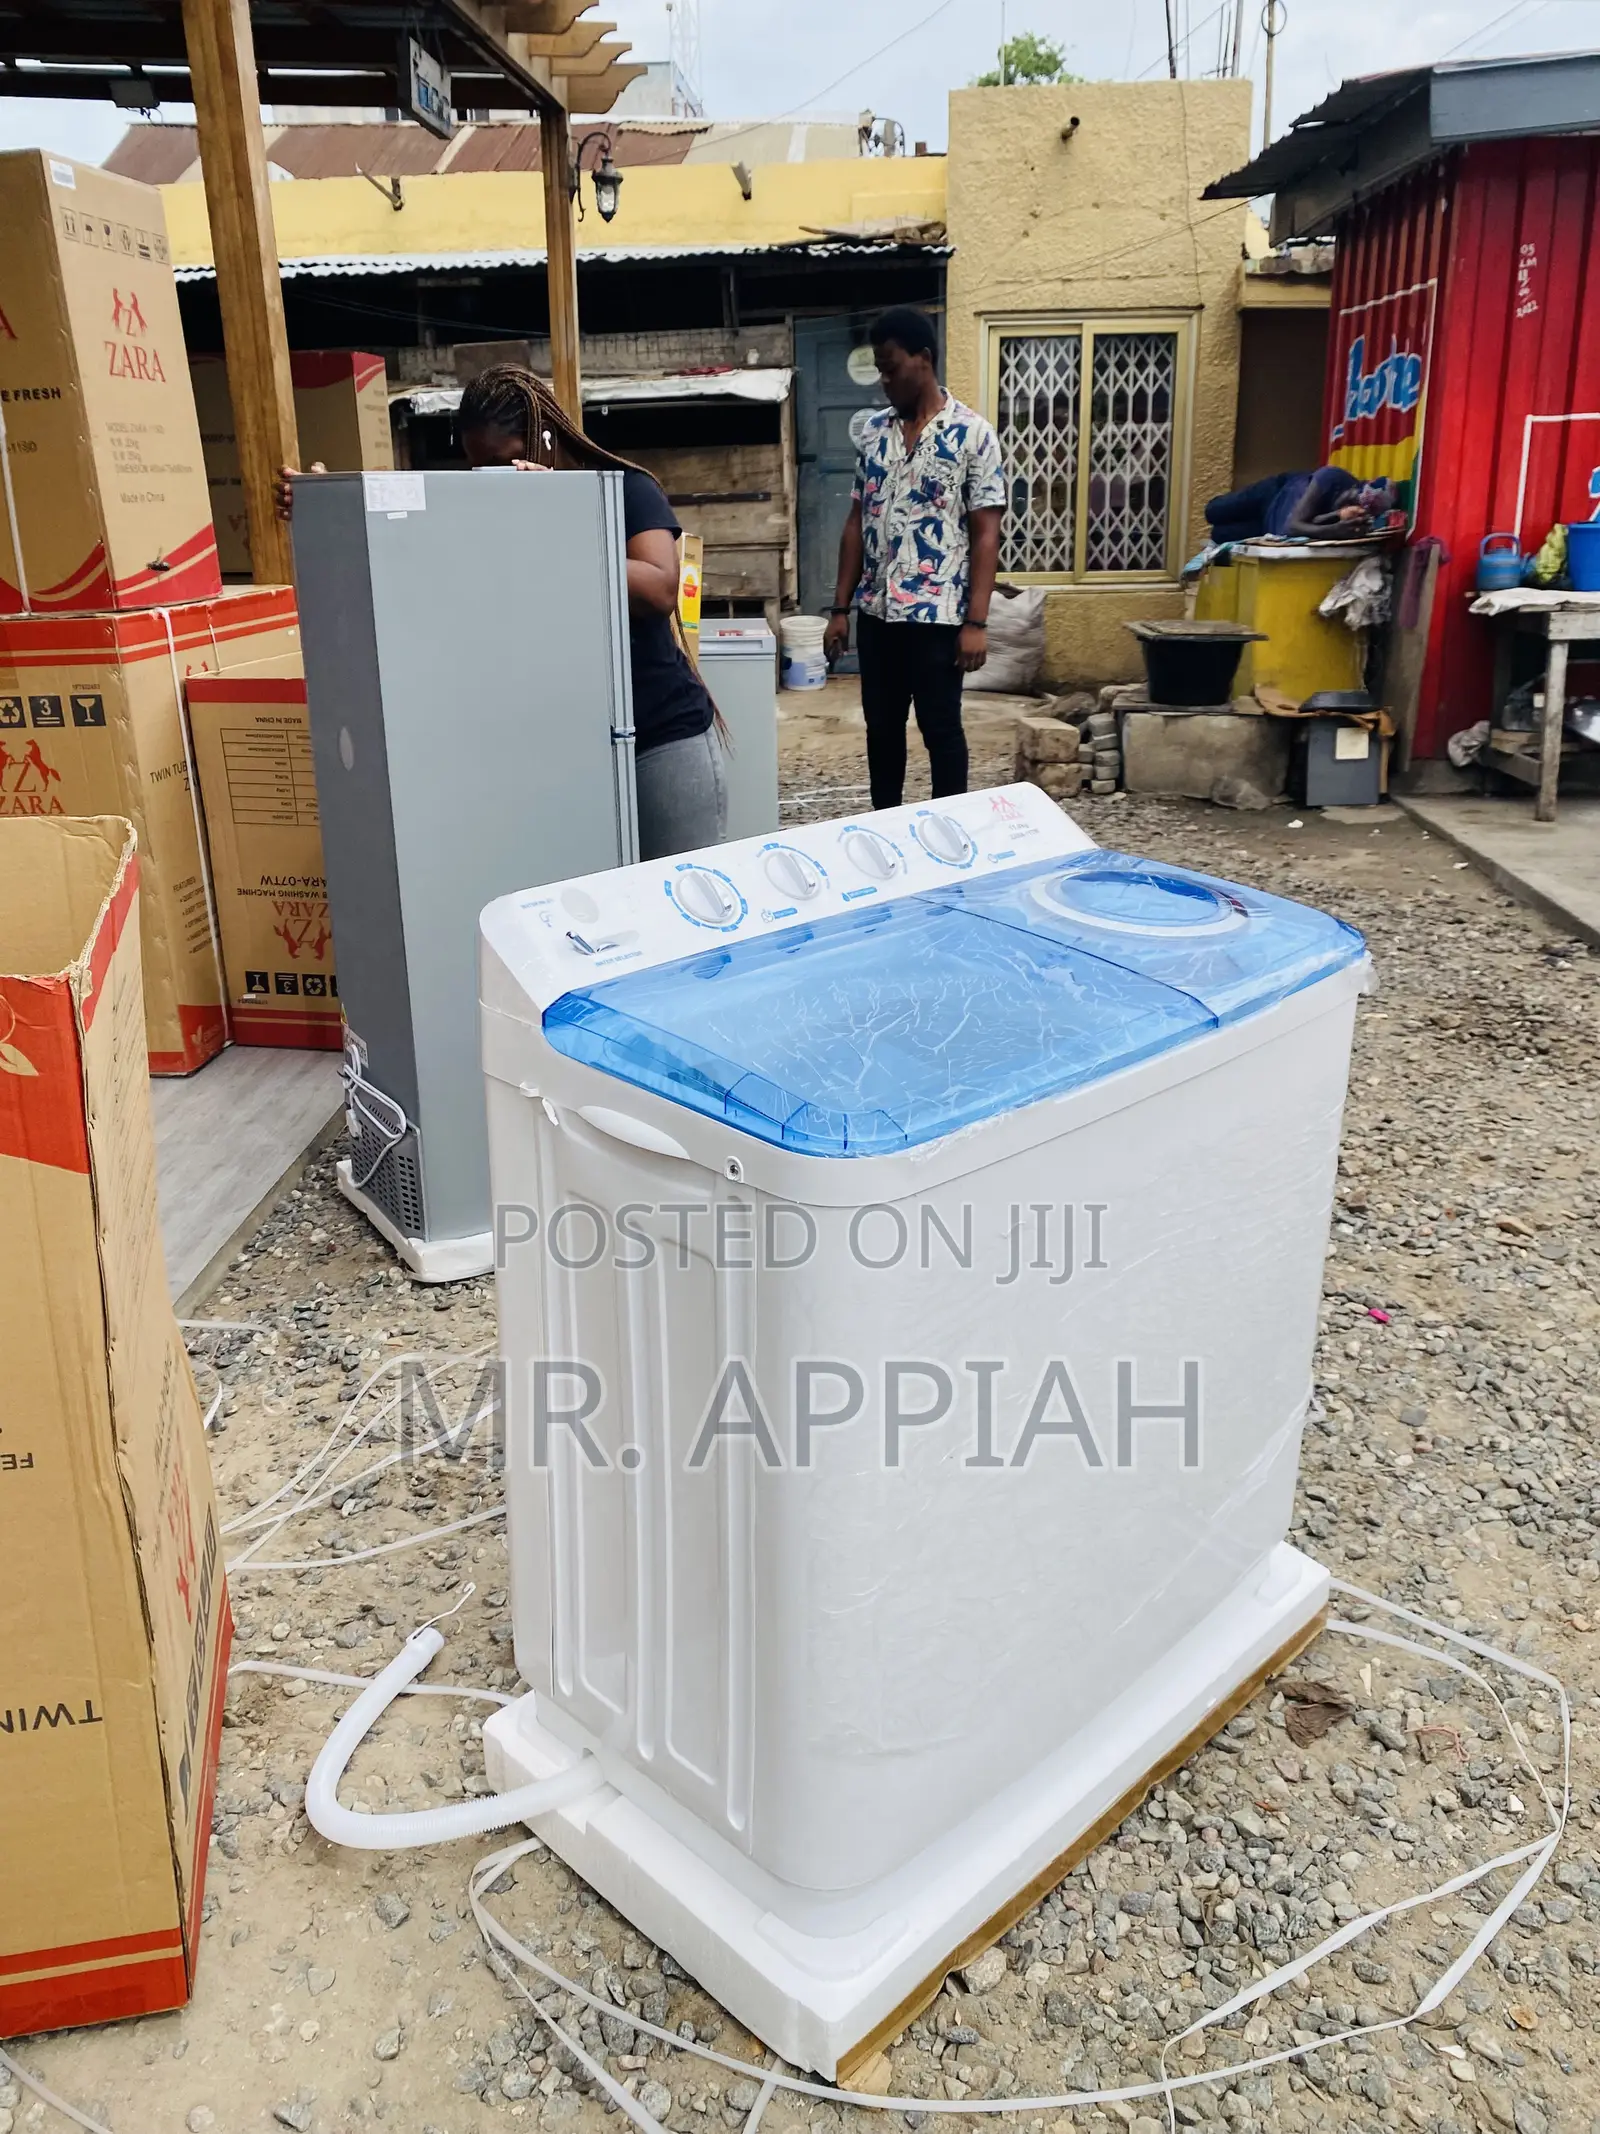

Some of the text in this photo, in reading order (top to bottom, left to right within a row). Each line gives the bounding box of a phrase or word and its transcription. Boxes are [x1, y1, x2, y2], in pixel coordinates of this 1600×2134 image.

[104, 340, 166, 383] ZARA
[13, 387, 61, 402] FRESH
[40, 698, 52, 716] 3
[150, 764, 172, 784] TWIN
[237, 888, 276, 897] MACHINE
[278, 889, 320, 899] WASHING
[272, 900, 330, 919] ZARA
